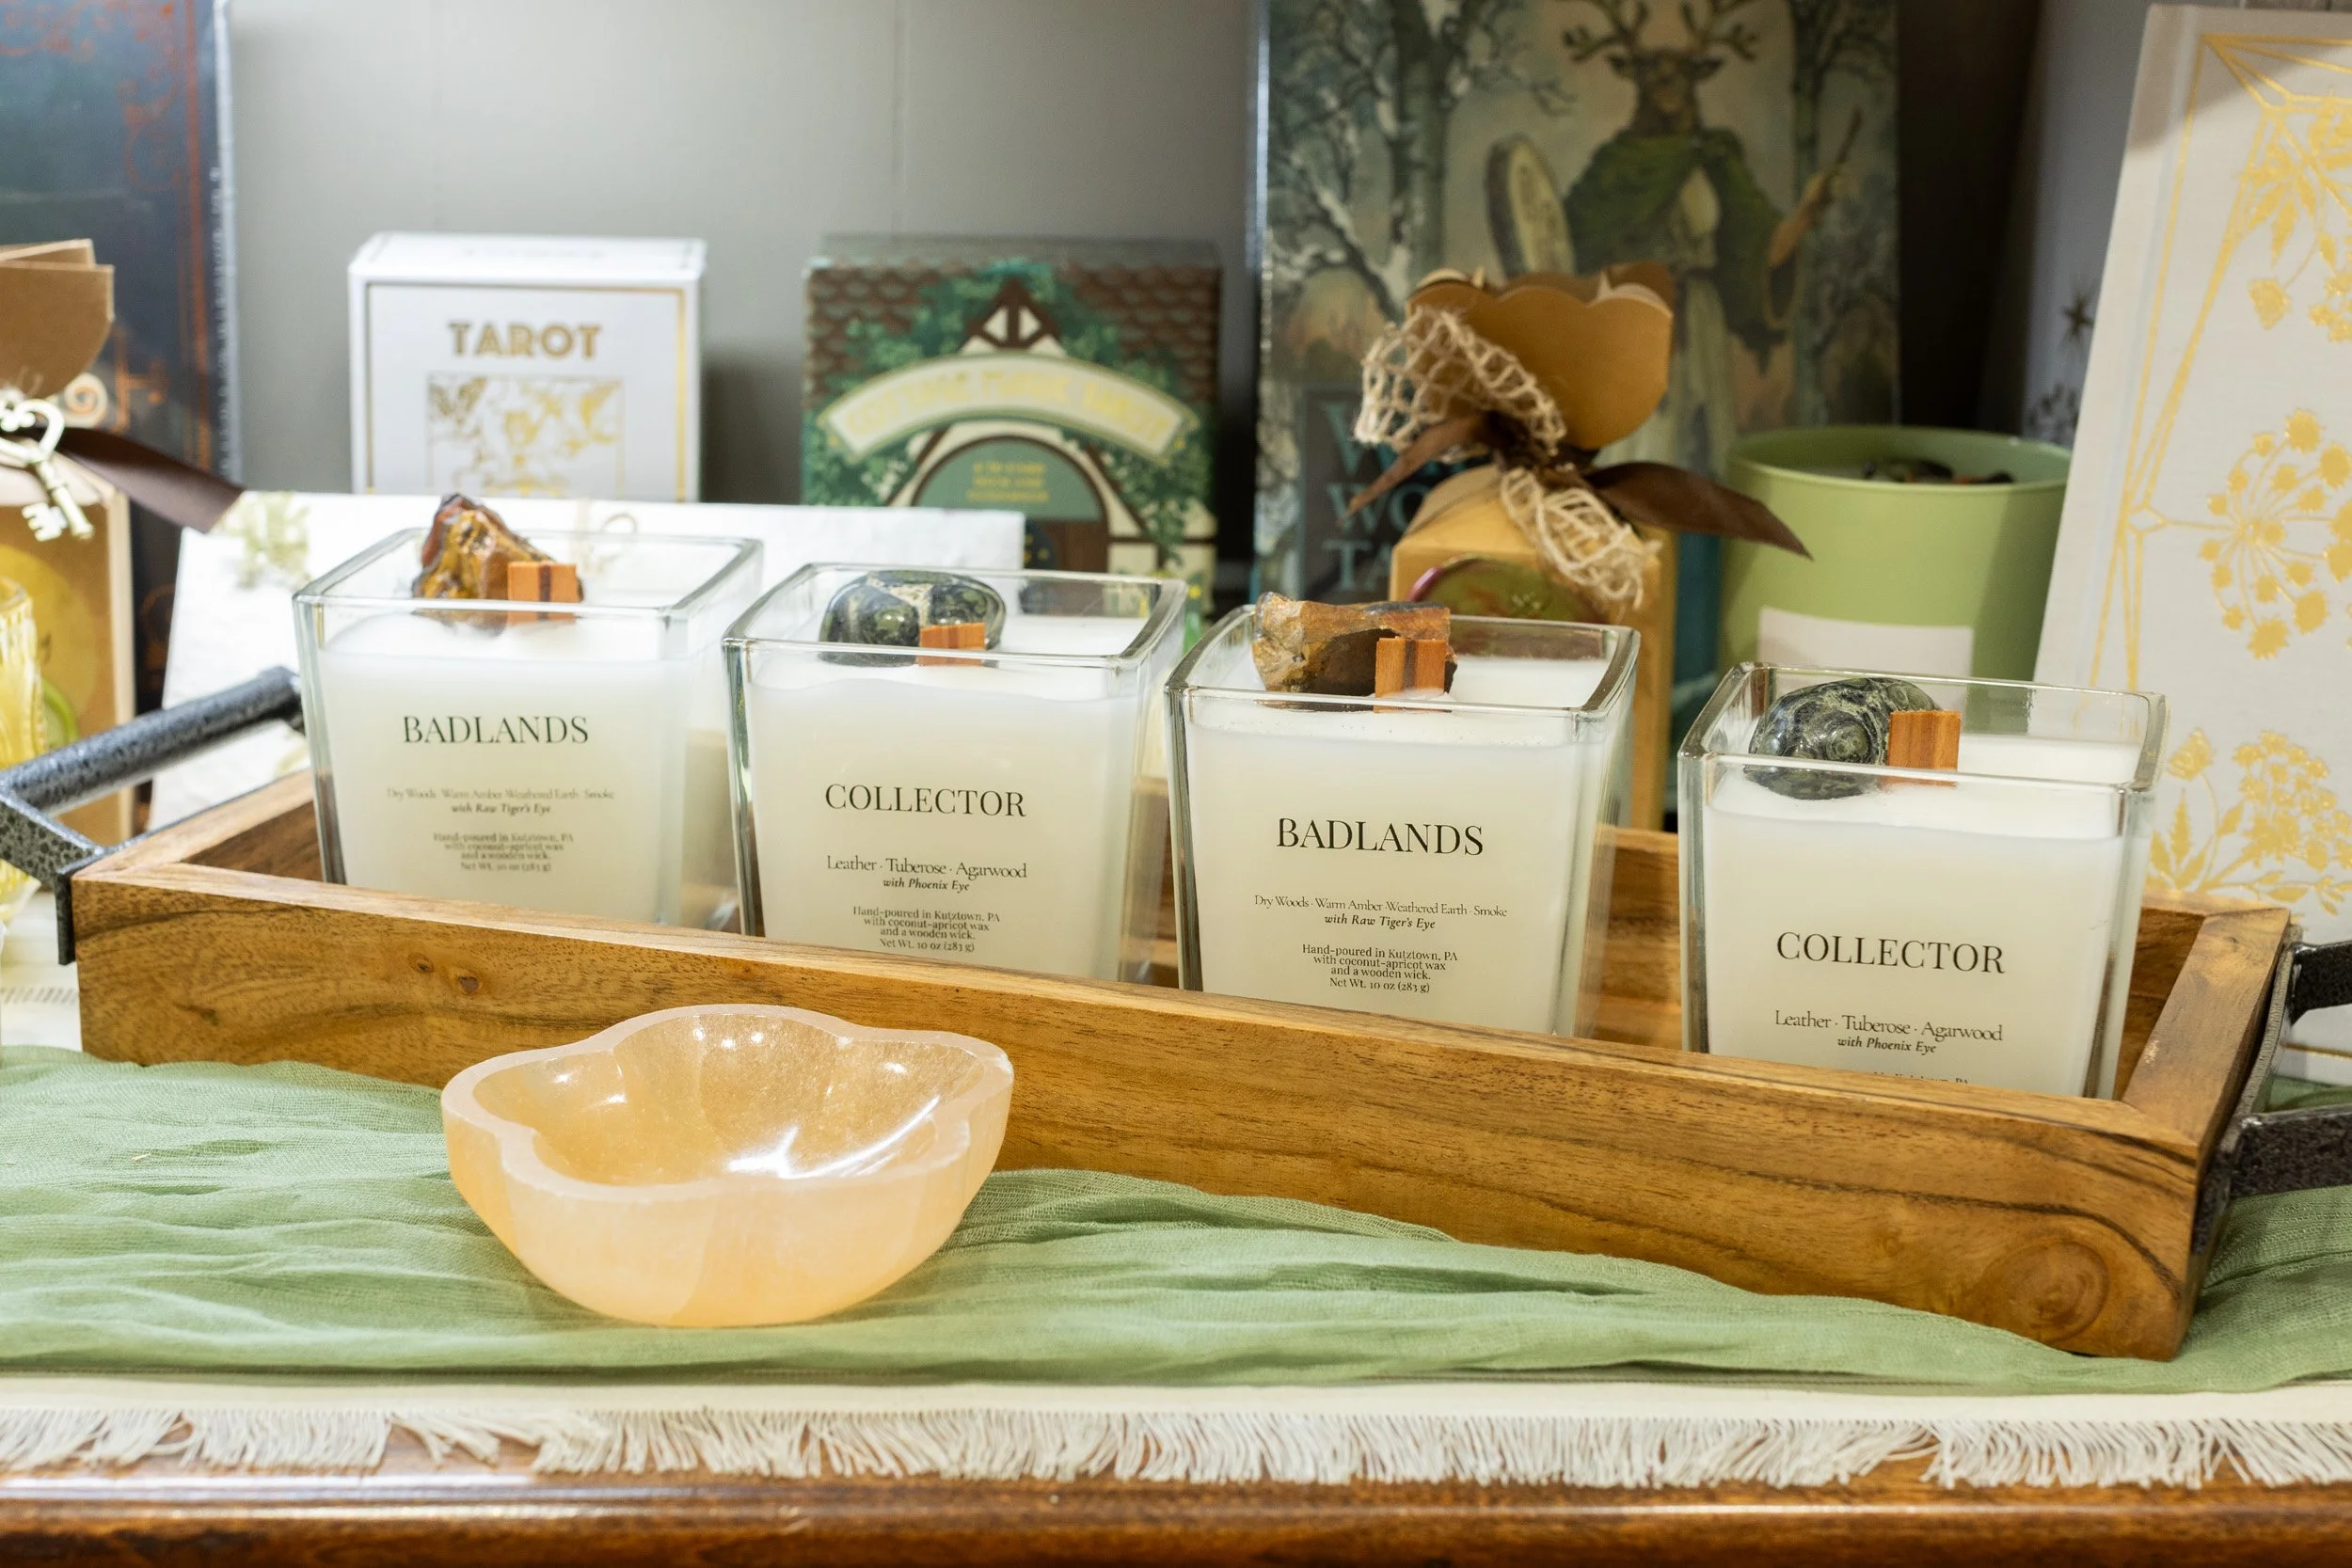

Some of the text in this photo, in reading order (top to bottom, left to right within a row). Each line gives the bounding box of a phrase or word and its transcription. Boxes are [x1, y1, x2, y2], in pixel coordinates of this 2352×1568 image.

[447, 321, 602, 359] TAROT
[403, 716, 589, 743] BADLANDS
[825, 784, 1026, 817] COLLECTOR
[452, 803, 472, 813] with
[475, 803, 497, 813] Raw
[533, 803, 551, 816] Eye
[500, 832, 508, 842] in
[1276, 817, 1484, 856] BADLANDS
[827, 855, 1027, 881] Leather Tuberose Agarwood
[883, 879, 970, 894] with Phoenix Eye
[852, 906, 919, 920] Hand-poured
[922, 911, 931, 919] in
[987, 912, 1000, 922] PA
[1254, 895, 1507, 917] Dry Woods Warm Amber Weathered Earth Smoke
[864, 917, 990, 931] with coconut-apricot wax
[1325, 914, 1436, 931] with Raw Tiger's Eye
[880, 927, 898, 937] and
[909, 929, 947, 939] wooden
[949, 929, 976, 940] wick.
[880, 939, 896, 948] Net
[944, 942, 962, 953] (283
[964, 942, 975, 953] g)
[1302, 944, 1458, 961] Hand-poured in Kutztown, PA
[1776, 931, 2006, 974] COLLECTOR
[1313, 954, 1446, 971] with coconut-apricot wax
[1330, 965, 1350, 976] and
[1360, 967, 1402, 978] wooden
[1404, 970, 1431, 980] wick.
[1329, 977, 1347, 988] Net
[1349, 978, 1366, 990] Wt.
[1370, 981, 1381, 990] 10
[1397, 982, 1418, 993] (283
[1420, 982, 1430, 993] g)
[1775, 1009, 2003, 1042] Leather Tuberose Agarwood
[1837, 1037, 1937, 1055] with Phoenix Eye
